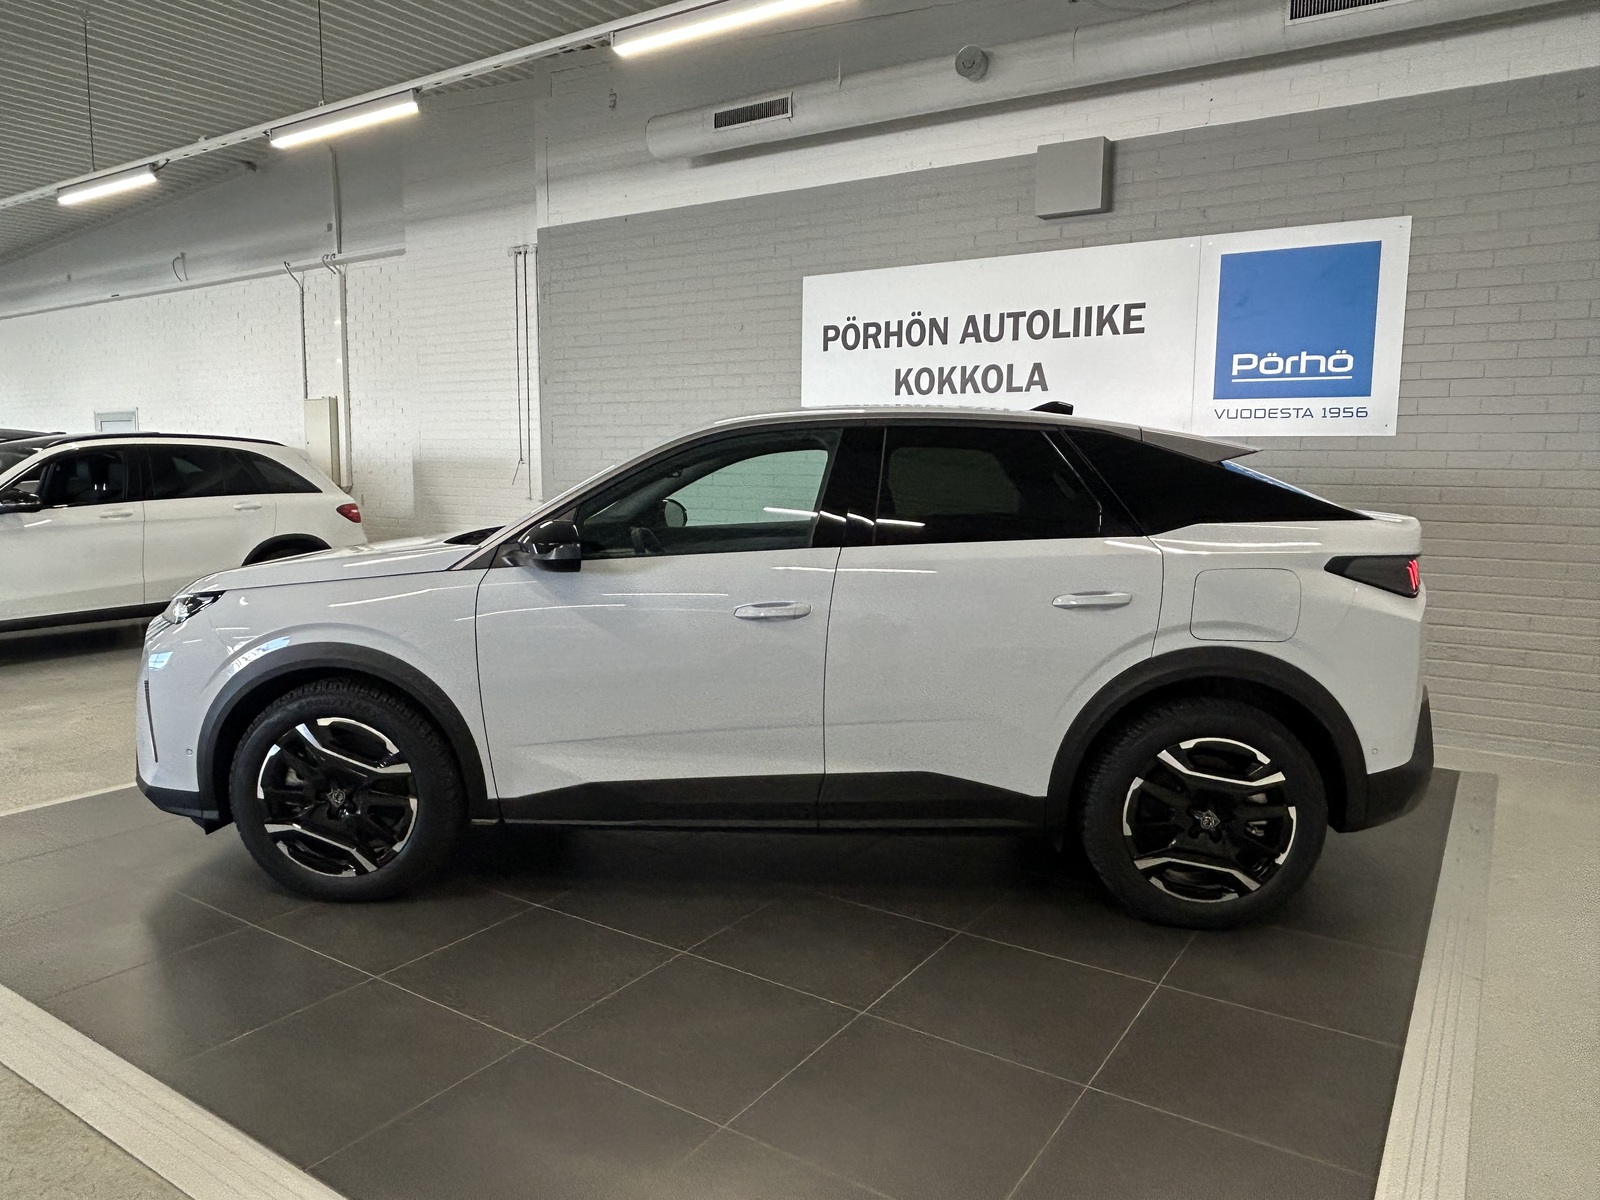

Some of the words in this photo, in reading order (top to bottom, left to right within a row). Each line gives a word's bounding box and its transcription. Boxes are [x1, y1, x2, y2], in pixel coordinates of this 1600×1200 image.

[822, 311, 949, 352] PÖRHÖN
[959, 302, 1147, 345] AUTOLIIKE
[1231, 349, 1354, 376] Pörhö
[894, 363, 1049, 396] KOKKOLA
[1214, 408, 1314, 420] VUODESTA
[1321, 406, 1369, 419] 1956
